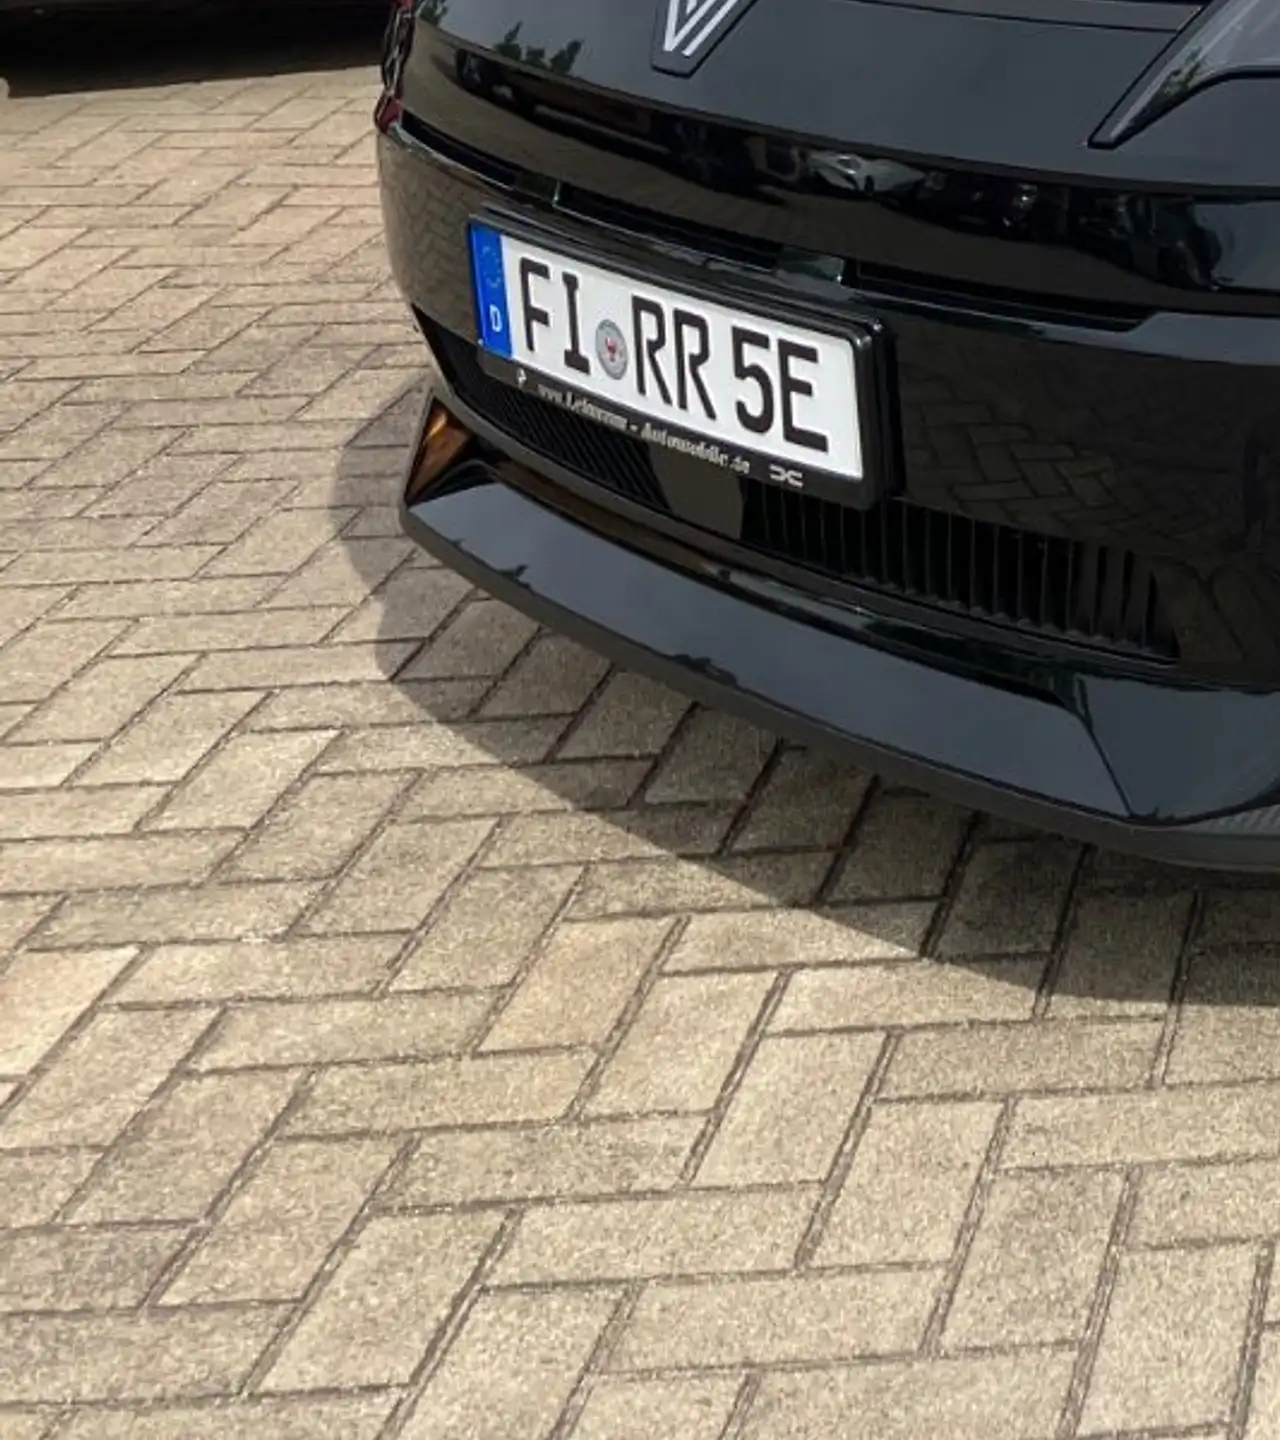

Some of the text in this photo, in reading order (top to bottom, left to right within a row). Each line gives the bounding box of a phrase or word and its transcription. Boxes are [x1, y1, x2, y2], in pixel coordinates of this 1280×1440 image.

[489, 303, 503, 333] D
[519, 256, 828, 453] FI RR 5E
